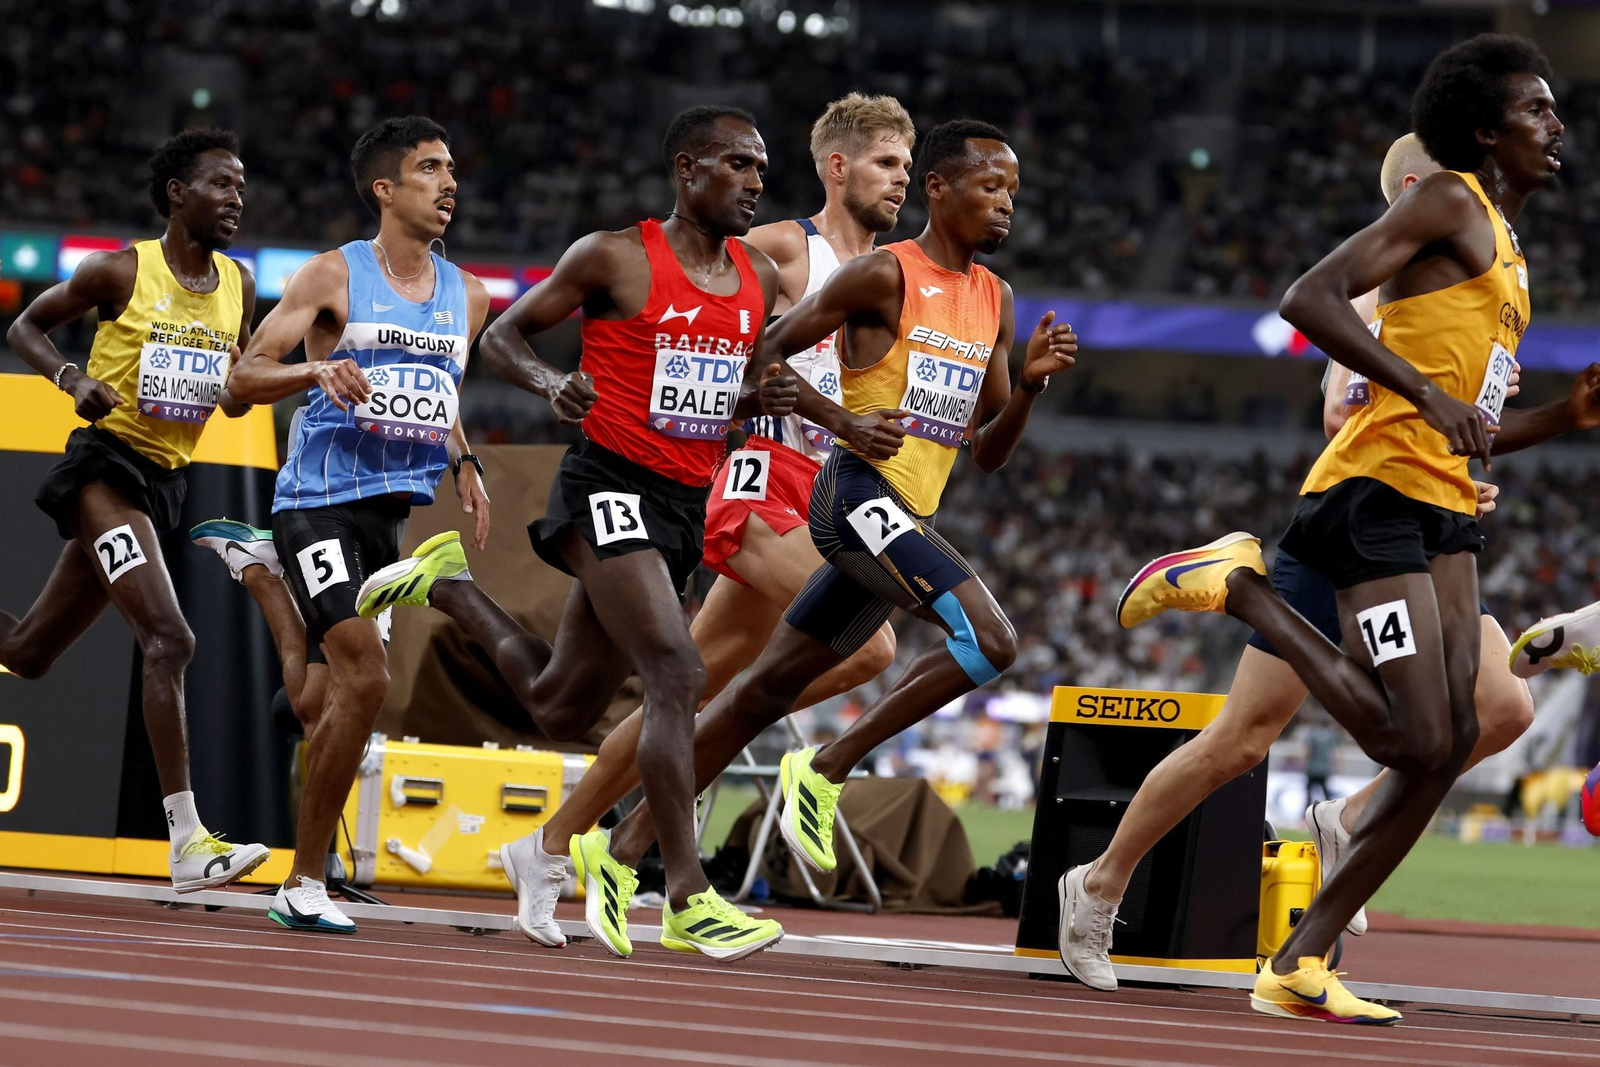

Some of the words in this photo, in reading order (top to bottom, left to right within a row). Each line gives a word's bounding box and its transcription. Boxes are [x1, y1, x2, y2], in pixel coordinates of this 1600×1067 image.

[149, 332, 203, 349] REFUGEE
[151, 321, 187, 334] WORLD
[190, 327, 236, 343] ATHLETICS
[378, 329, 455, 353] URUGUAY
[654, 332, 754, 357] BAHRA
[172, 349, 223, 376] TDK
[691, 356, 744, 384] TDK
[939, 361, 984, 393] TDK
[142, 374, 167, 398] EISA
[170, 377, 220, 405] MOHAMMED
[390, 367, 452, 395] TDK
[1348, 388, 1365, 399] 25
[369, 391, 448, 423] SOCA
[659, 385, 738, 416] BALEW
[733, 457, 763, 493] 12
[596, 499, 639, 535] 13
[864, 506, 900, 540] 2
[98, 532, 141, 576] 22
[311, 547, 334, 584] 5
[1362, 611, 1407, 656] 14
[1076, 694, 1181, 723] SEIKO
